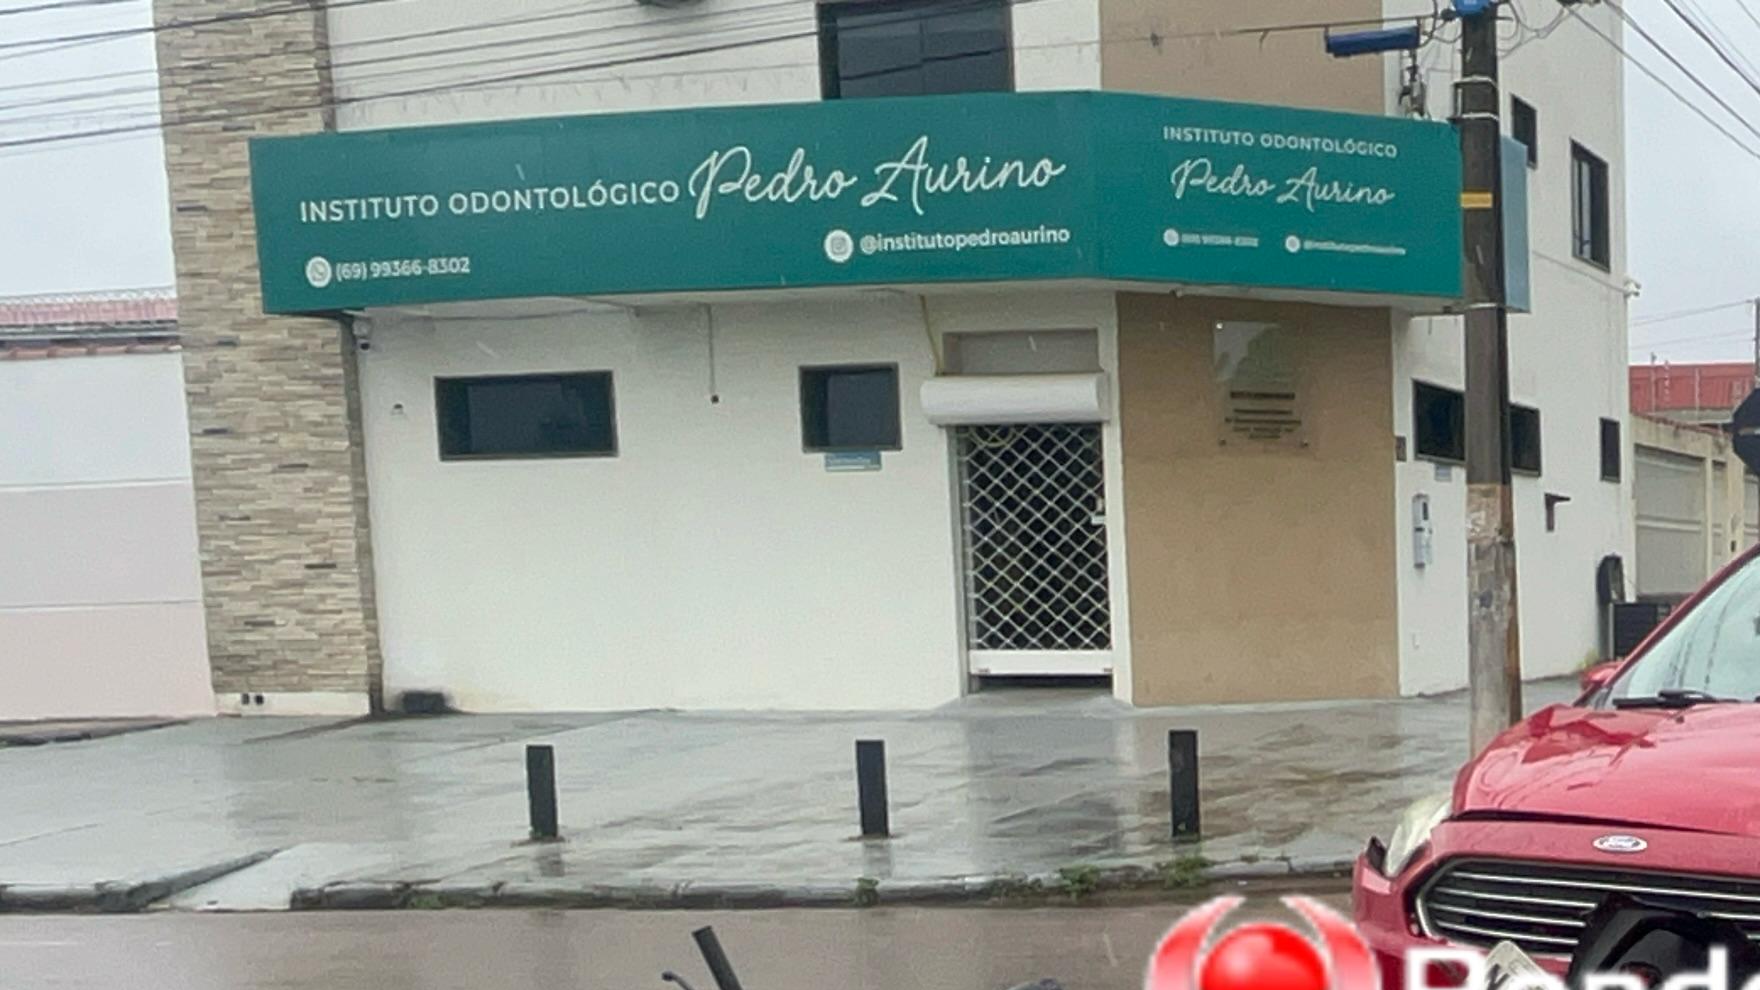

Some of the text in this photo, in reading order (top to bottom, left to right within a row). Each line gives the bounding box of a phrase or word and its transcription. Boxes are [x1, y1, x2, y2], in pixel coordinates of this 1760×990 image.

[1163, 125, 1397, 158] INSTITUTO ODONTOLÓGICO
[688, 135, 1067, 219] Pedro Aurino
[1170, 158, 1395, 212] Pedro Aurino
[300, 180, 680, 223] INSTITUTO ODONTOLÓGICO
[860, 224, 1071, 255] @institutopedroaurino
[335, 257, 471, 281] (69) 99366-8302
